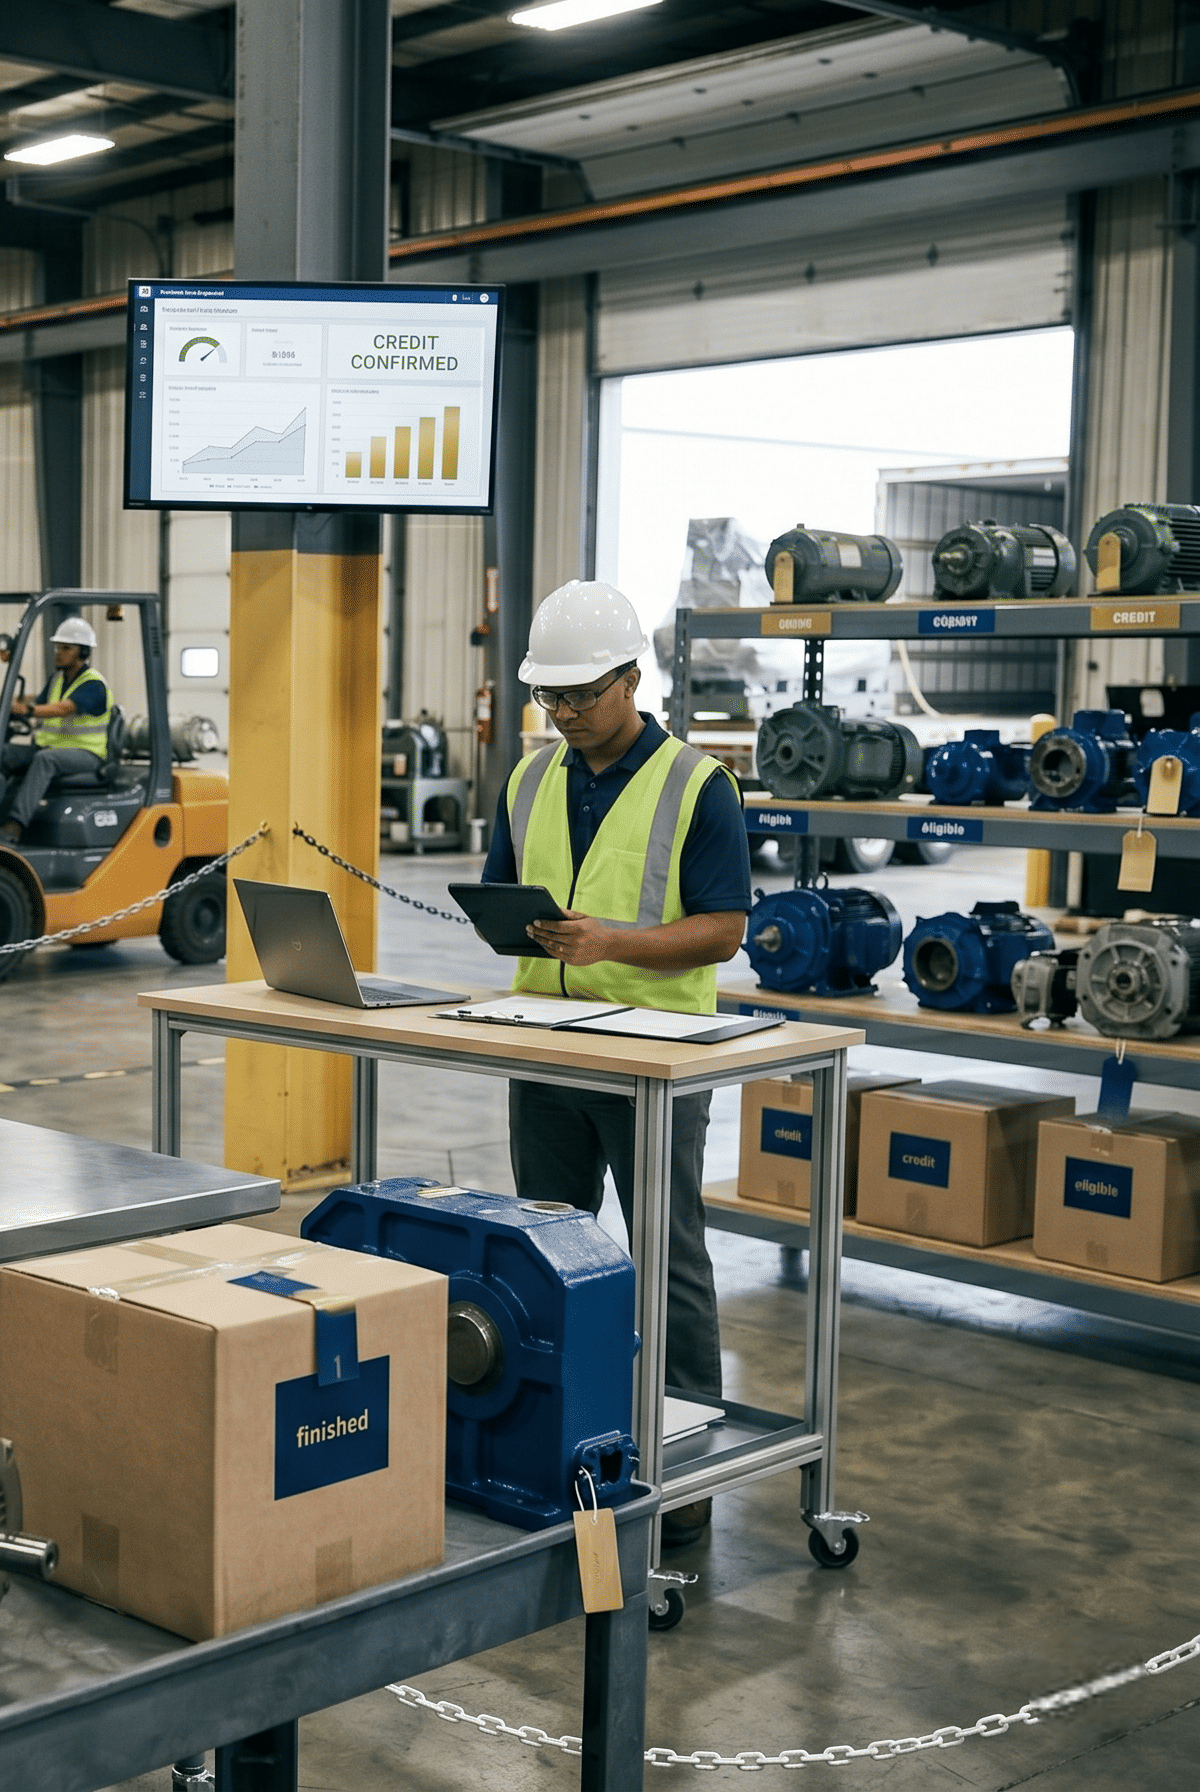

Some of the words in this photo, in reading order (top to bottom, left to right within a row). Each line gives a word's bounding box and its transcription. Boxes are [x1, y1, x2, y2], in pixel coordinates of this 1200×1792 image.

[373, 334, 440, 350] CREDIT
[351, 354, 459, 371] CONFIRMED
[1112, 610, 1157, 624] CREDIT
[296, 1408, 369, 1448] finished
